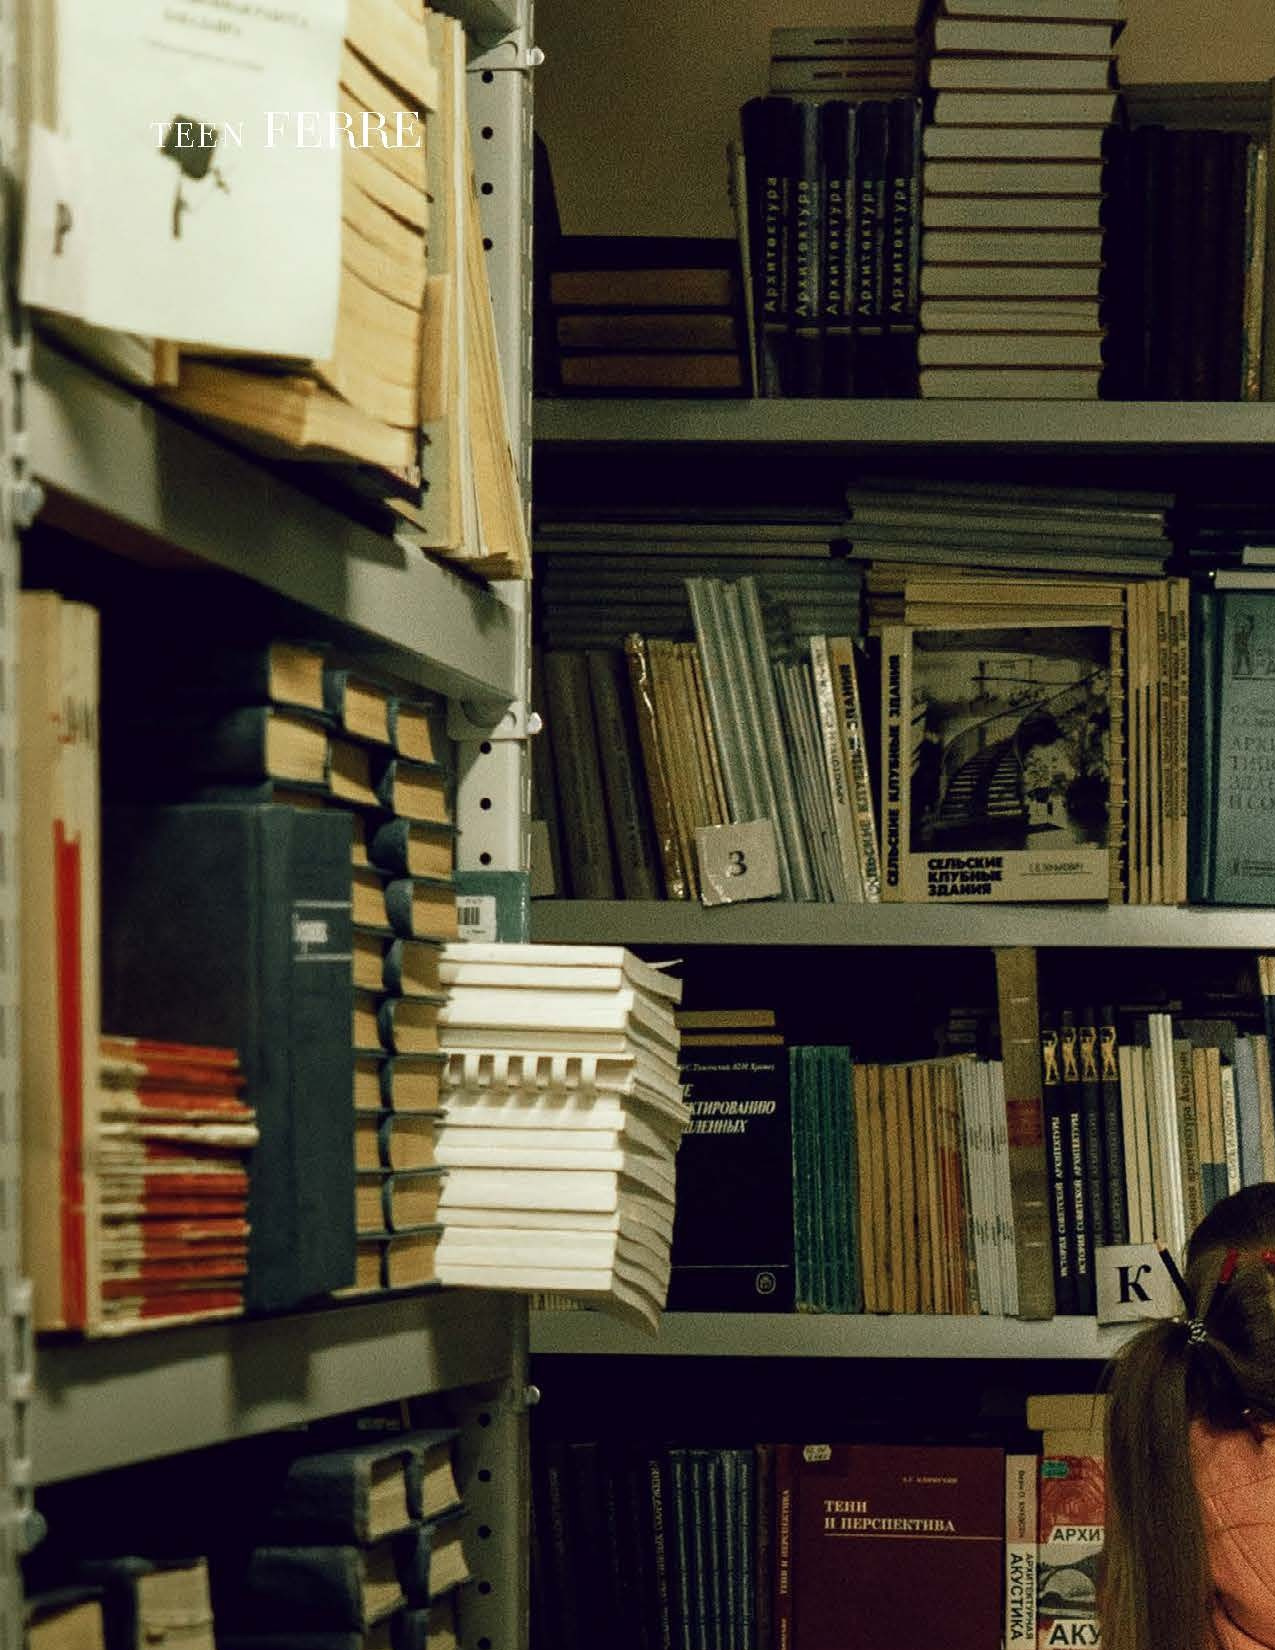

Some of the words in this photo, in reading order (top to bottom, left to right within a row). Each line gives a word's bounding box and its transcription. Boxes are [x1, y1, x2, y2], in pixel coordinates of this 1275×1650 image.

[763, 177, 782, 312] Архитектура
[795, 180, 811, 317] Архитектура
[825, 180, 843, 315] Архитектура
[857, 180, 876, 315] Архитектура
[889, 178, 907, 312] Архитектура
[888, 655, 900, 718] ЗДАНИЯ
[888, 725, 900, 803] КЛУБНЫЕ
[887, 808, 900, 886] СЕЛЬСКИЕ
[928, 856, 1003, 870] СЕЛЬСКИЕ
[928, 870, 1003, 883] КЛУБНЫЕ
[928, 883, 992, 896] ЗДАНИЯ
[688, 1100, 777, 1115] КТИРОВАНИЮ
[1115, 1265, 1152, 1304] К
[824, 1500, 868, 1513] ТЕНИ
[824, 1516, 836, 1530] И
[841, 1517, 958, 1532] ПЕРСПЕКТИВА
[1053, 1528, 1103, 1541] АРХИ
[1010, 1553, 1023, 1641] АКУСТИКА
[1026, 1553, 1035, 1641] АРХИТЕКТУРНАЯ
[1049, 1623, 1105, 1646] АКУ
